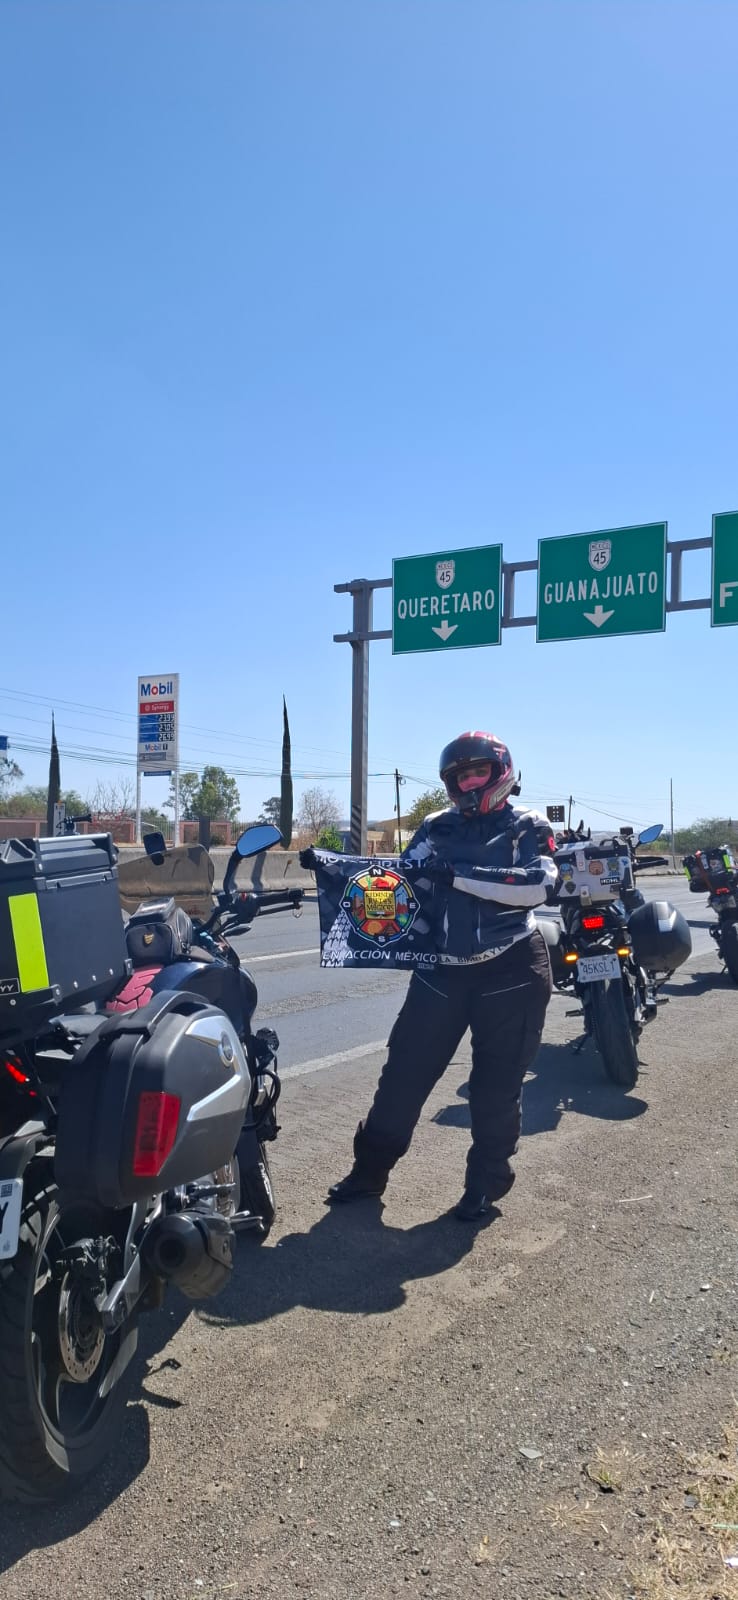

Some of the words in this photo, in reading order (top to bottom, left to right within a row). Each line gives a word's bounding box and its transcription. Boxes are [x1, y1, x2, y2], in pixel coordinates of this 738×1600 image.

[593, 551, 607, 565] 45
[439, 570, 451, 583] 45
[543, 571, 659, 604] GUANAJUATO
[397, 589, 496, 619] QUERETARO
[140, 681, 173, 697] Mobil
[372, 868, 382, 876] N
[378, 935, 386, 943] S
[322, 951, 340, 960] EN
[344, 948, 391, 960] ACCIÓN
[395, 950, 437, 963] MÉXICO
